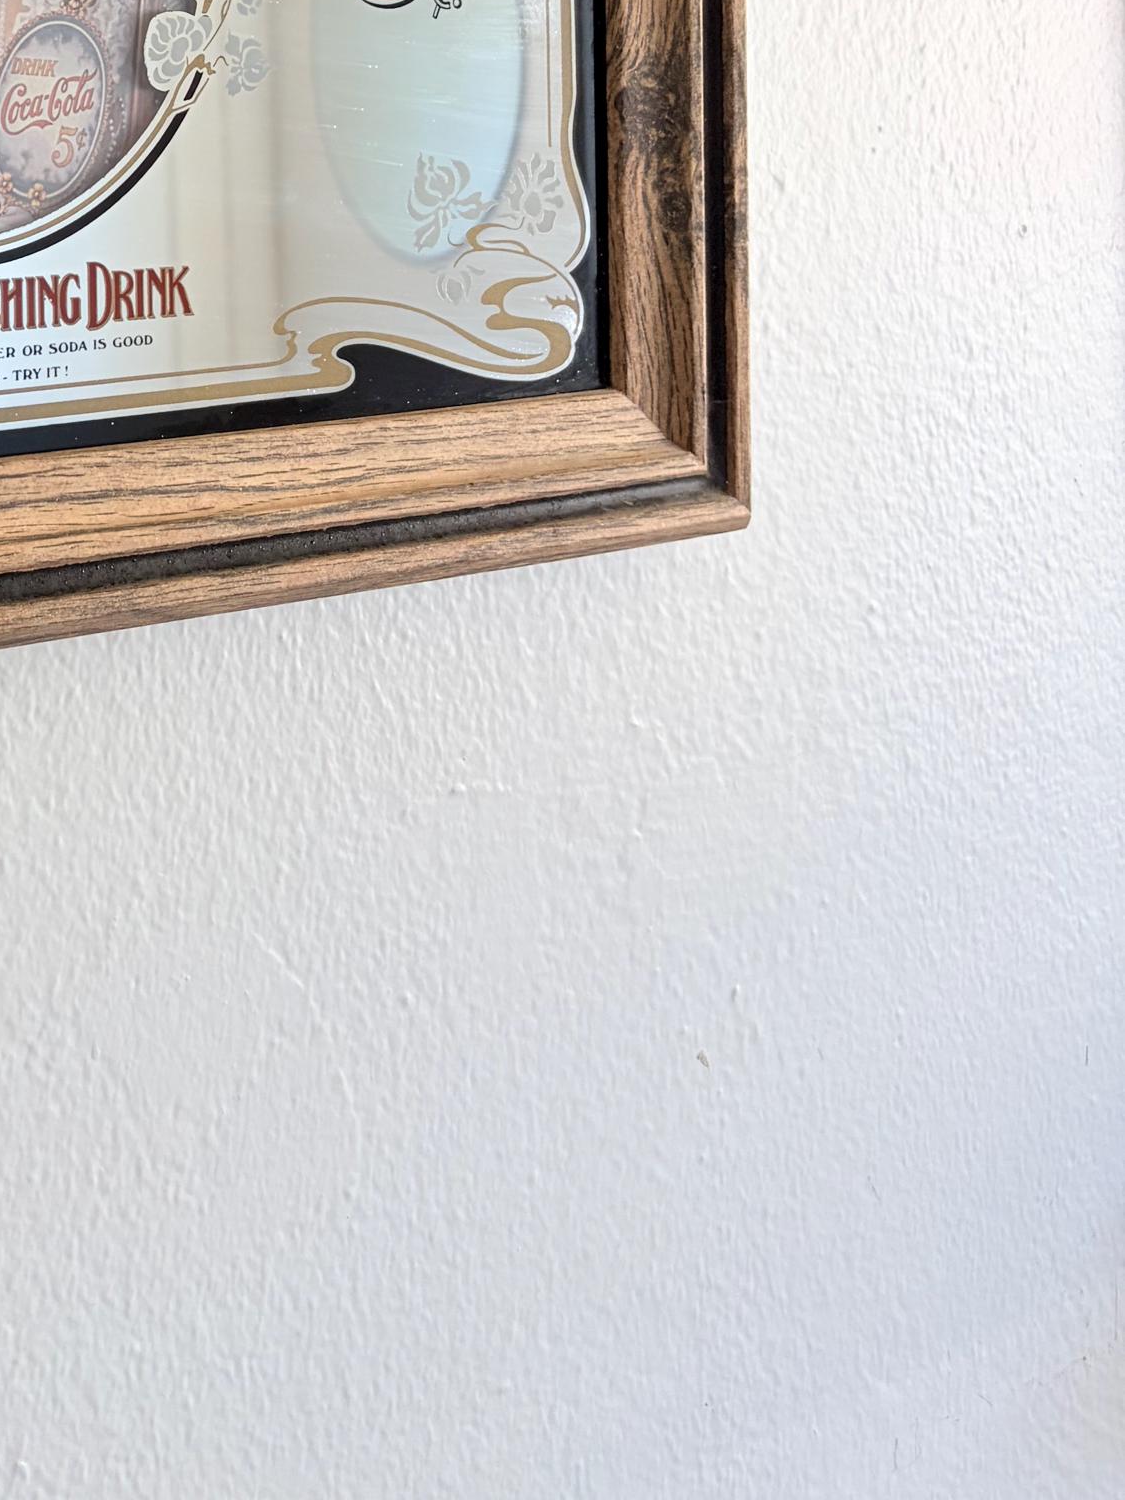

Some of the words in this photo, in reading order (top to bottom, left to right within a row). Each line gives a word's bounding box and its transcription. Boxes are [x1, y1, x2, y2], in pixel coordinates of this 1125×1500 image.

[11, 58, 59, 77] DRINK
[0, 68, 98, 136] Coca-Cola
[51, 125, 88, 168] 5¢
[86, 261, 194, 331] DRINK
[22, 344, 43, 357] OR
[48, 341, 88, 355] SODA
[93, 338, 107, 350] IS
[113, 334, 153, 348] GOOD
[12, 366, 42, 381] TRY
